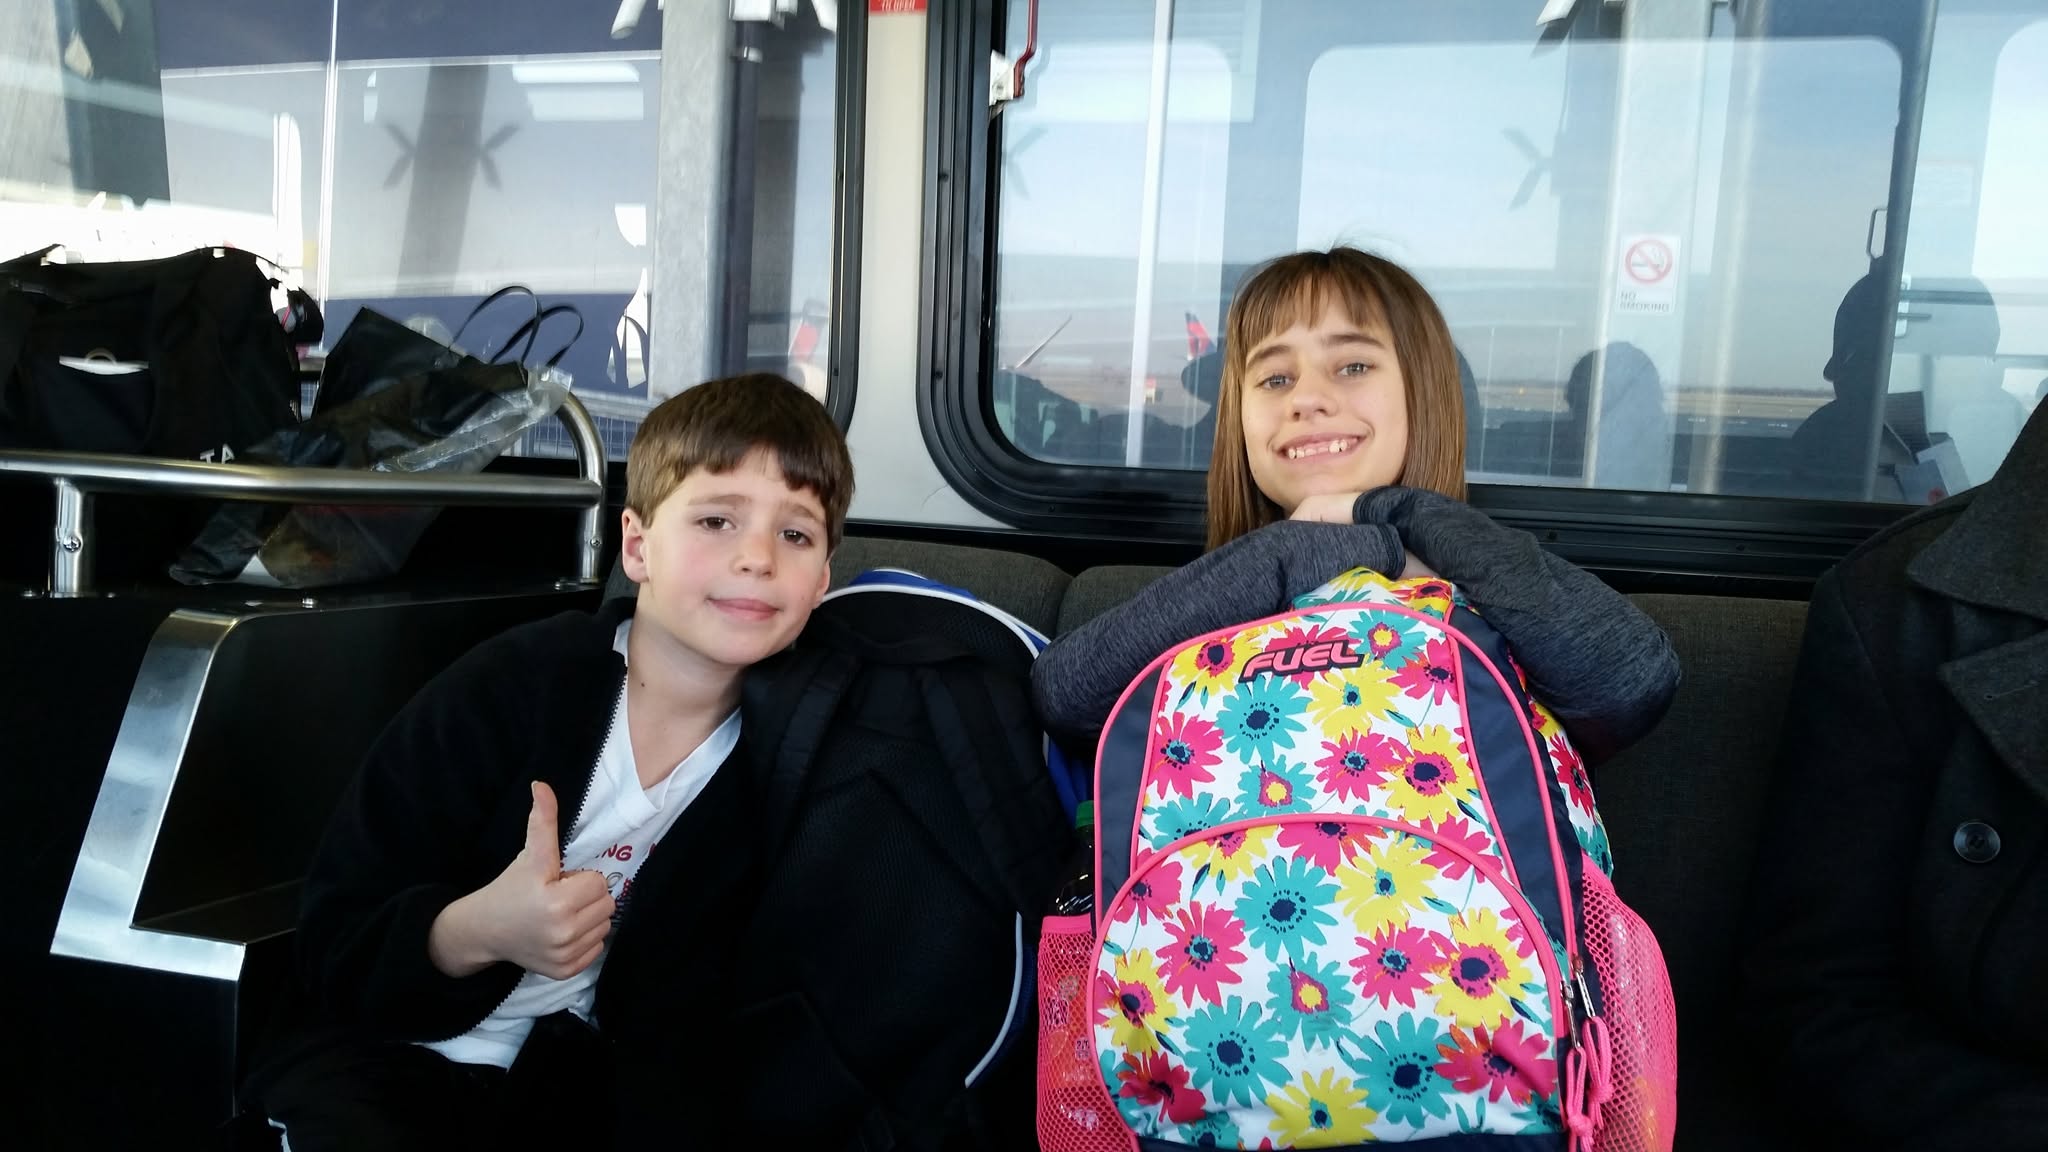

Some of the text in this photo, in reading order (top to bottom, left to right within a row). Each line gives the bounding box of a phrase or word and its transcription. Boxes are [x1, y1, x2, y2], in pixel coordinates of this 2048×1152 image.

[1620, 290, 1637, 300] NO
[1620, 302, 1669, 312] SMOKING
[1239, 640, 1363, 682] FUEL
[597, 843, 633, 862] NG
